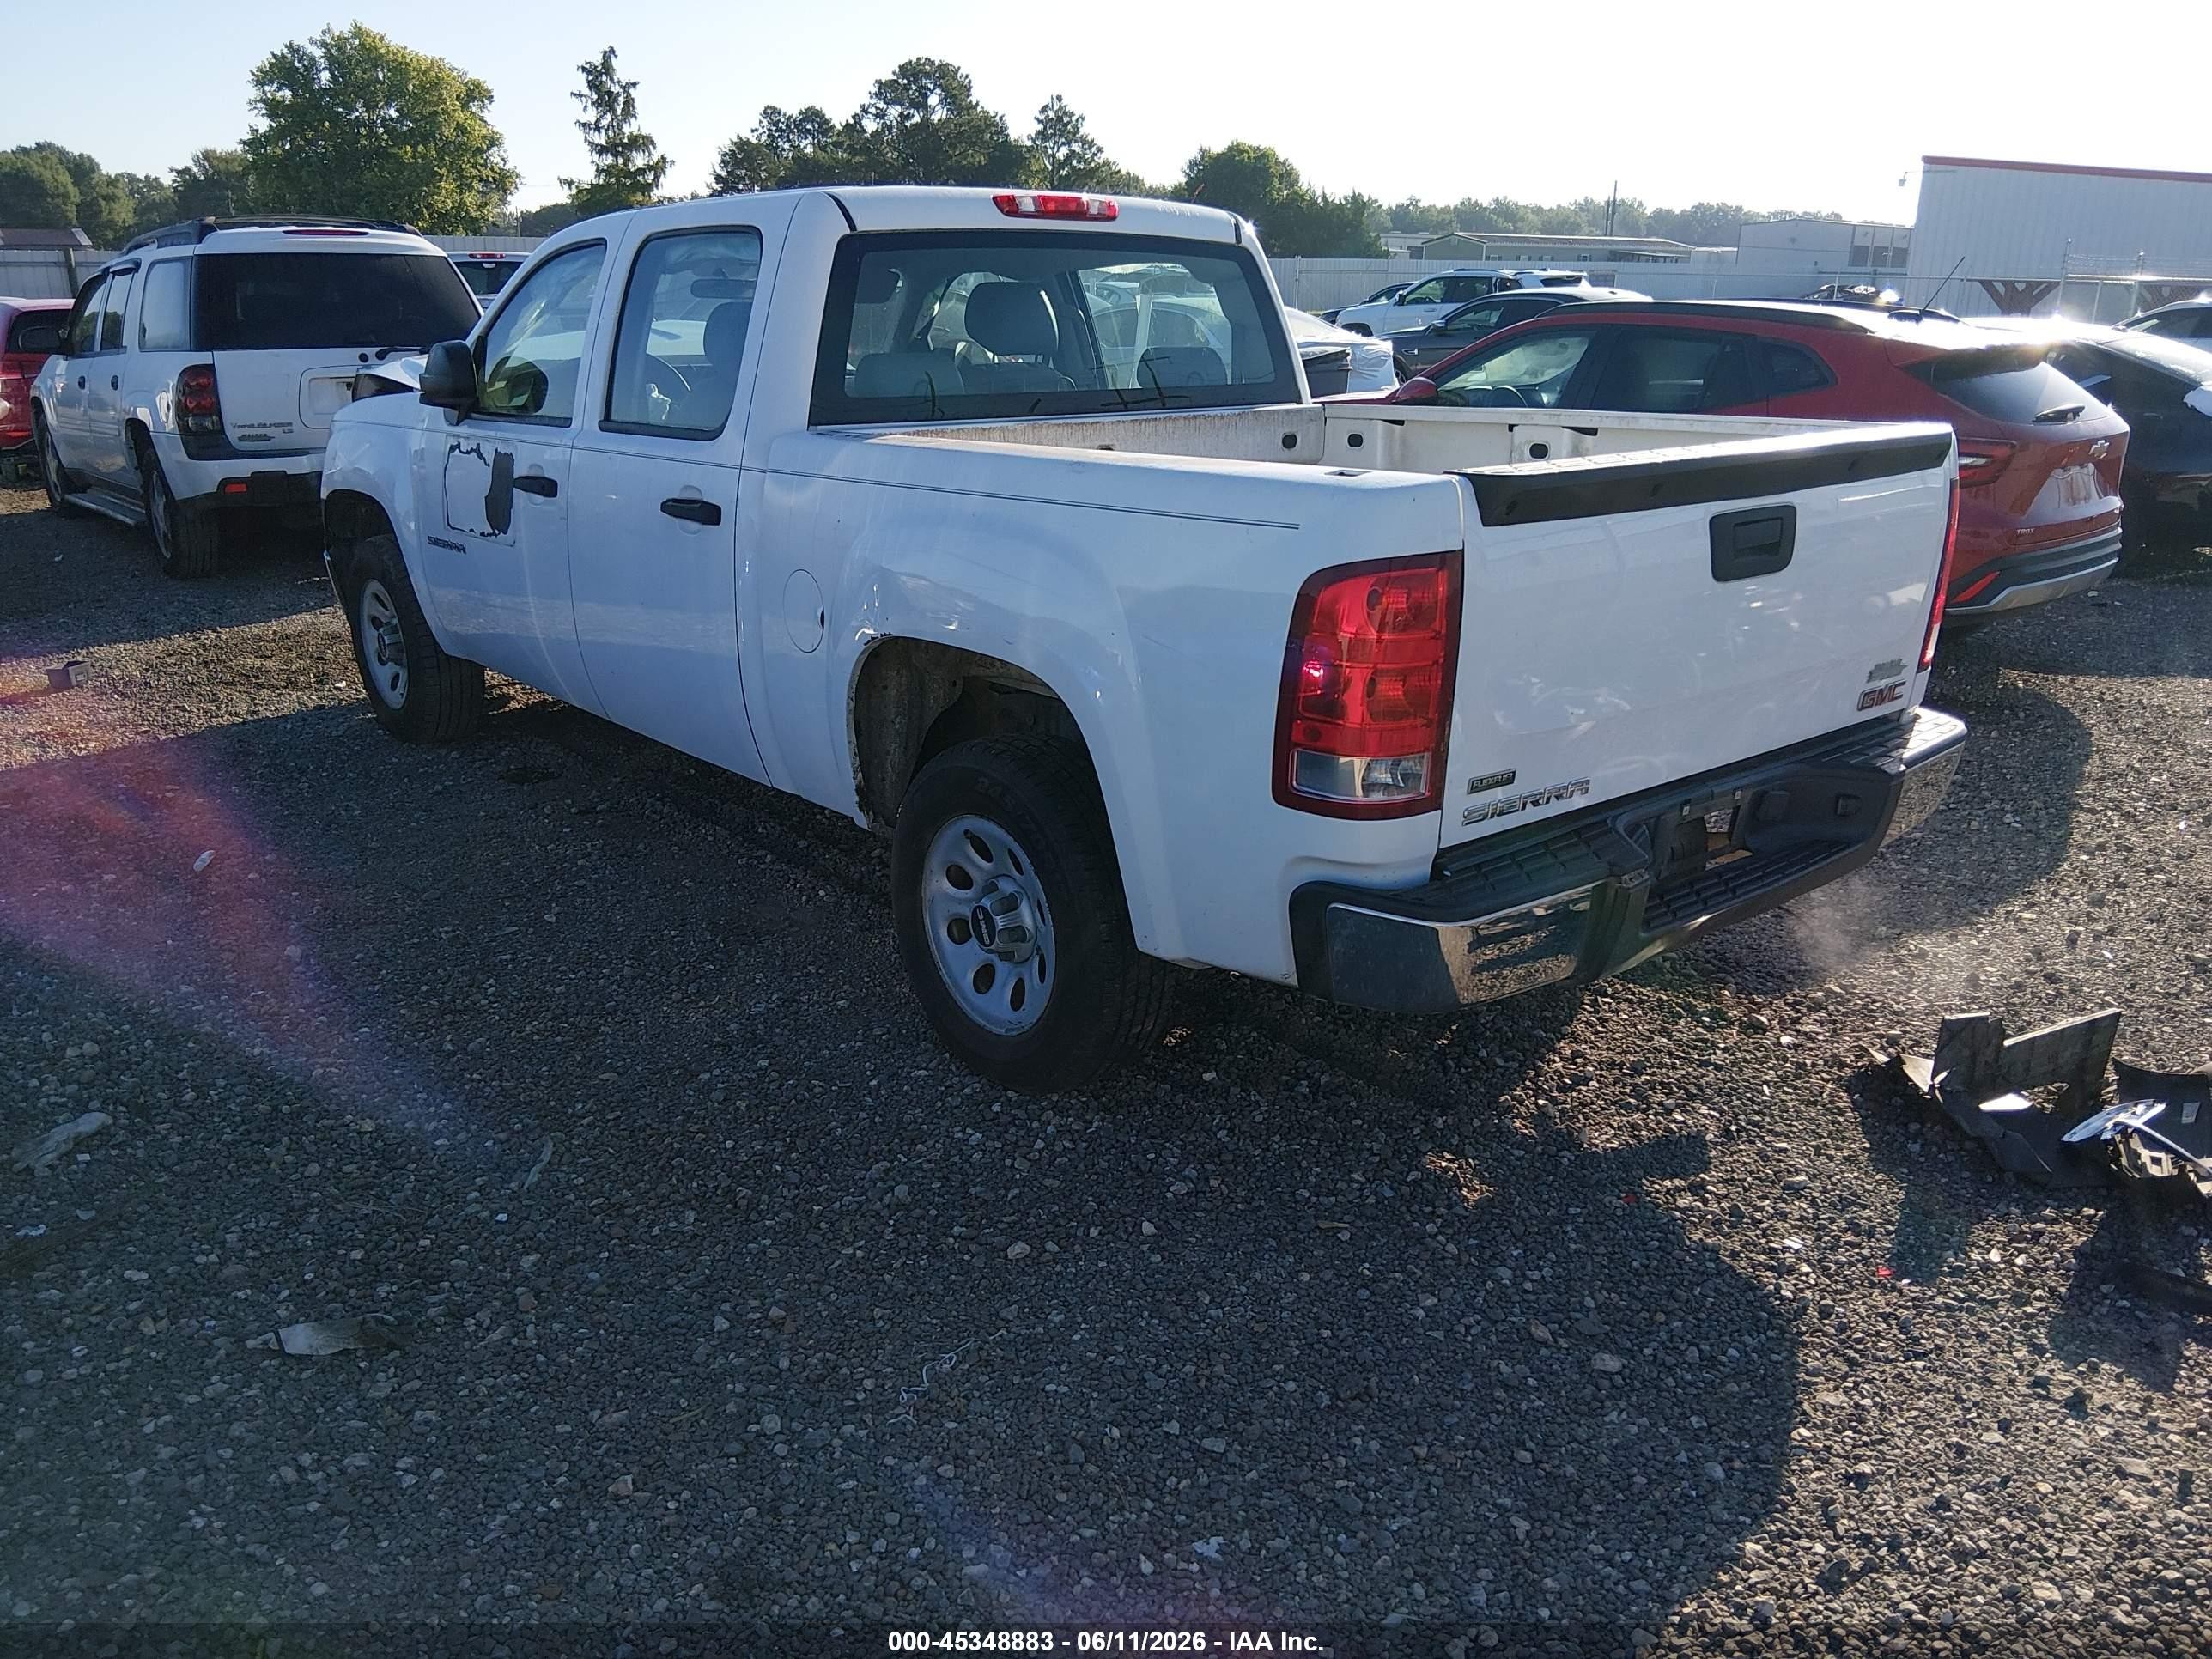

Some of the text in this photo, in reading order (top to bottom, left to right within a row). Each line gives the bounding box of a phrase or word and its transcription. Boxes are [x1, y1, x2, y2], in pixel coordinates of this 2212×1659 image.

[427, 535, 467, 555] SIERRA
[1857, 679, 1906, 711] GMC
[1462, 777, 1591, 826] SIERRA
[976, 907, 990, 945] GMC
